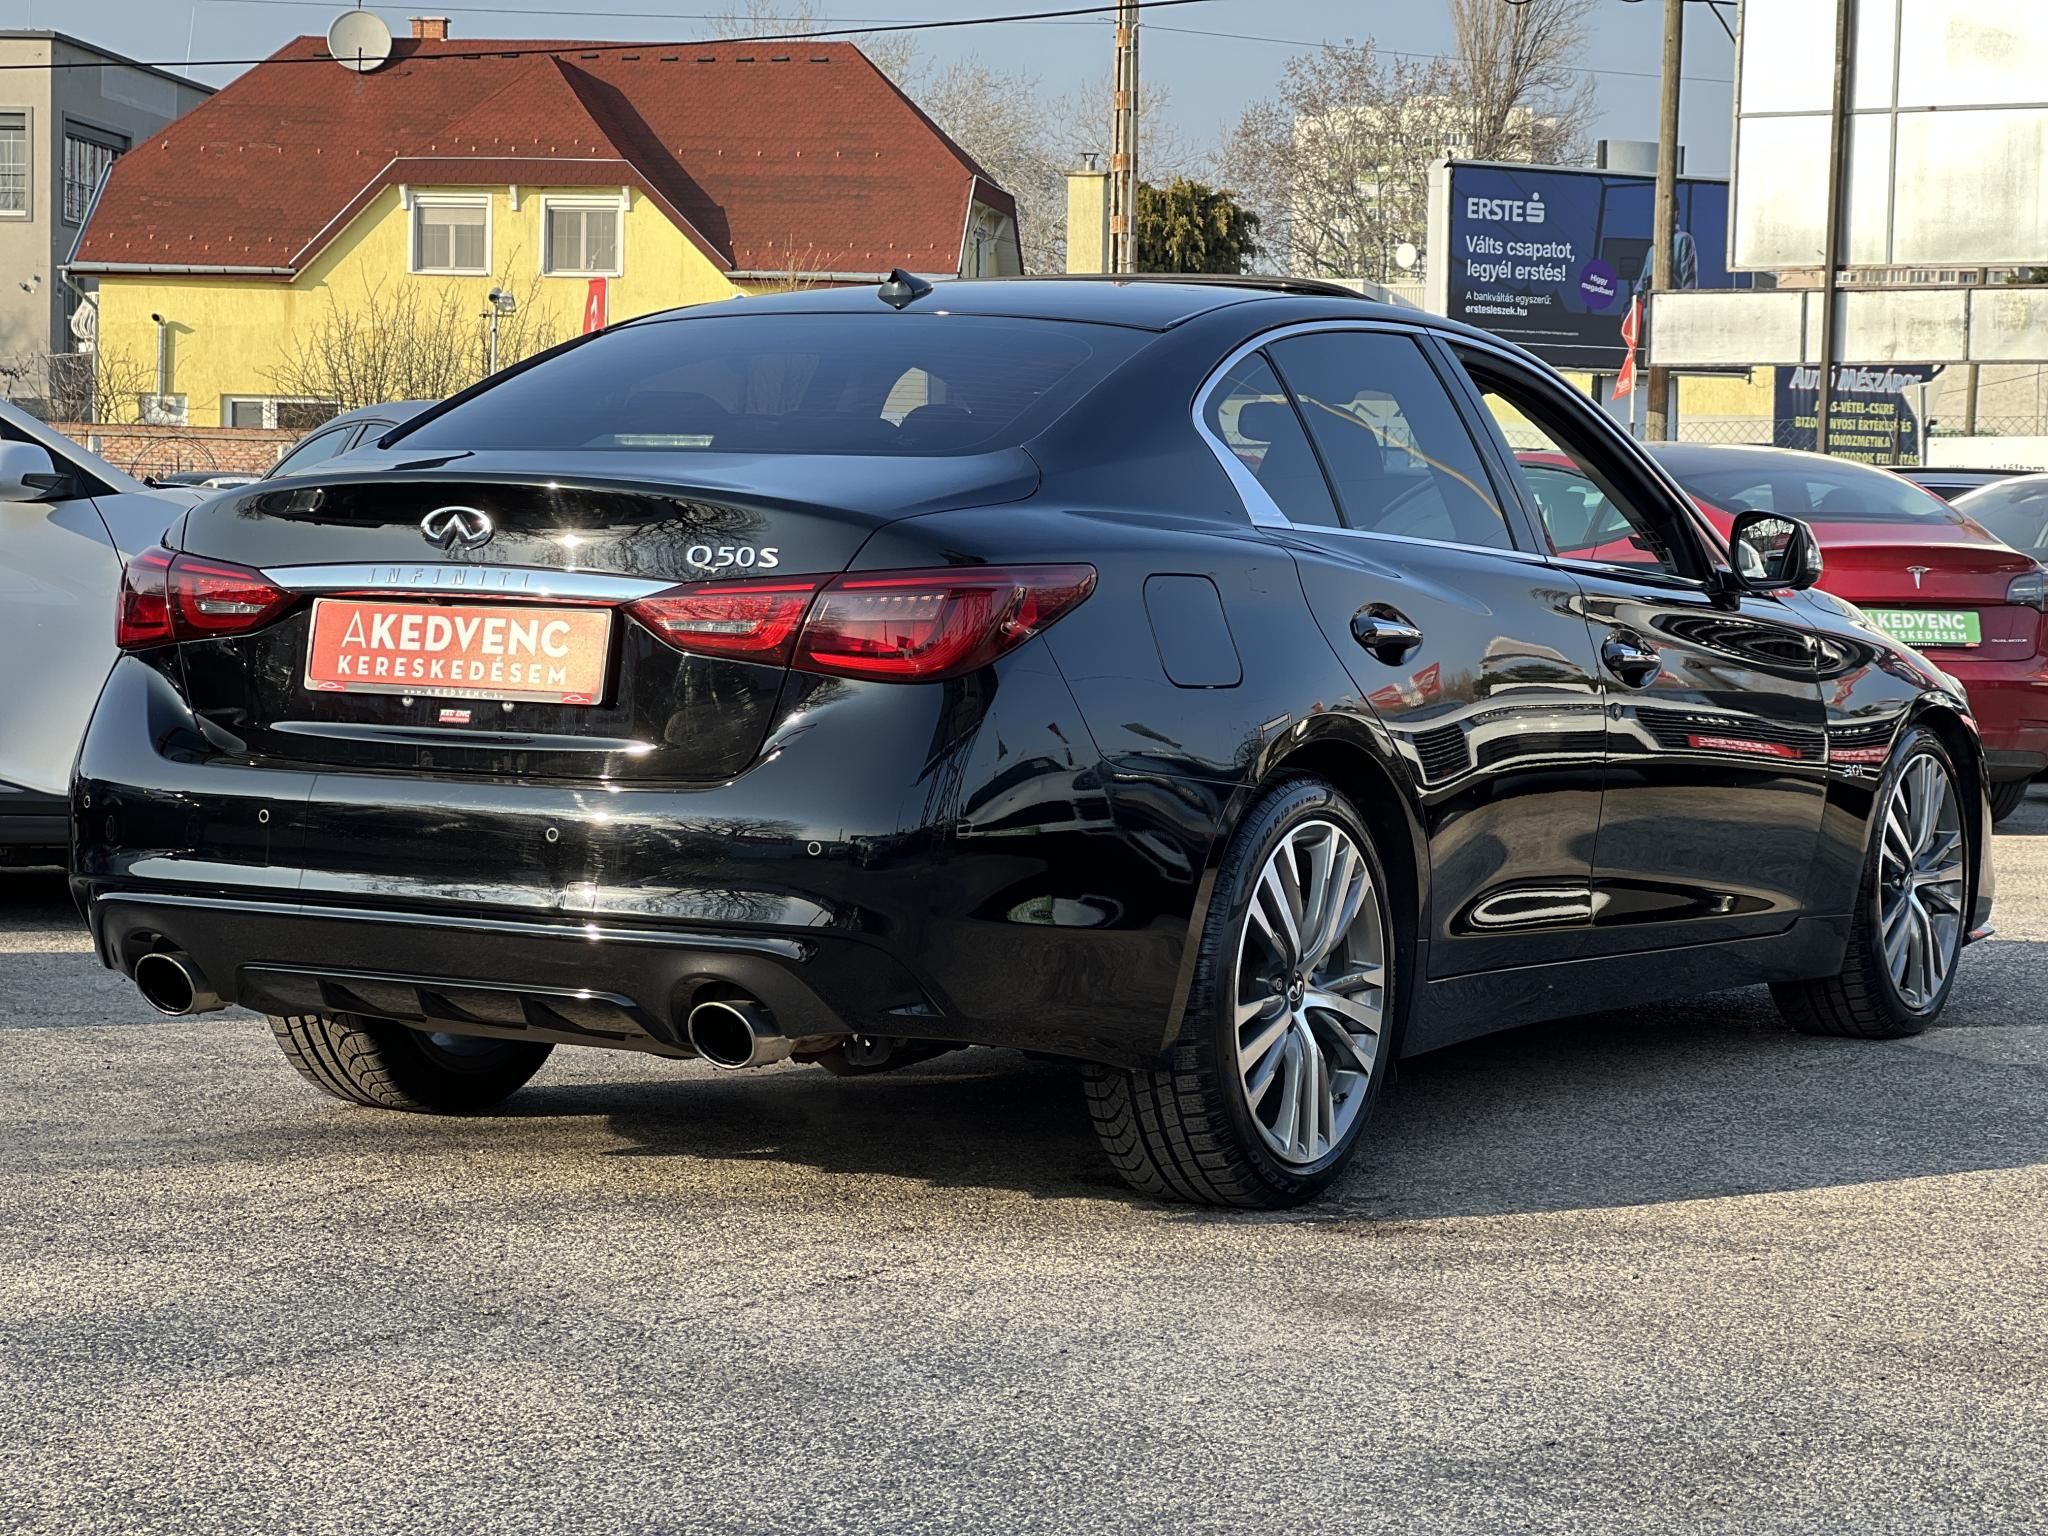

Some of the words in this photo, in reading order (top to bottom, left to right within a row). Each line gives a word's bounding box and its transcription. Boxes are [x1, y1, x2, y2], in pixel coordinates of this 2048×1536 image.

[1467, 197, 1524, 222] ERSTE
[1465, 235, 1503, 255] Válts
[1506, 241, 1576, 262] csapatot,
[1466, 259, 1512, 282] legyél
[1515, 260, 1567, 281] erstés!
[1590, 273, 1609, 287] Higgy
[1465, 290, 1472, 300] A
[1474, 290, 1514, 304] bankváltás
[1515, 293, 1552, 306] egyszerű:
[1465, 304, 1528, 317] erstesleszek.hu
[686, 545, 779, 573] Q50S
[367, 567, 531, 590] INFINITI
[341, 609, 571, 658] AKEDVENC
[1891, 629, 1968, 640] ESKEDÉSEM
[337, 655, 567, 687] KERESKEDÉSEM
